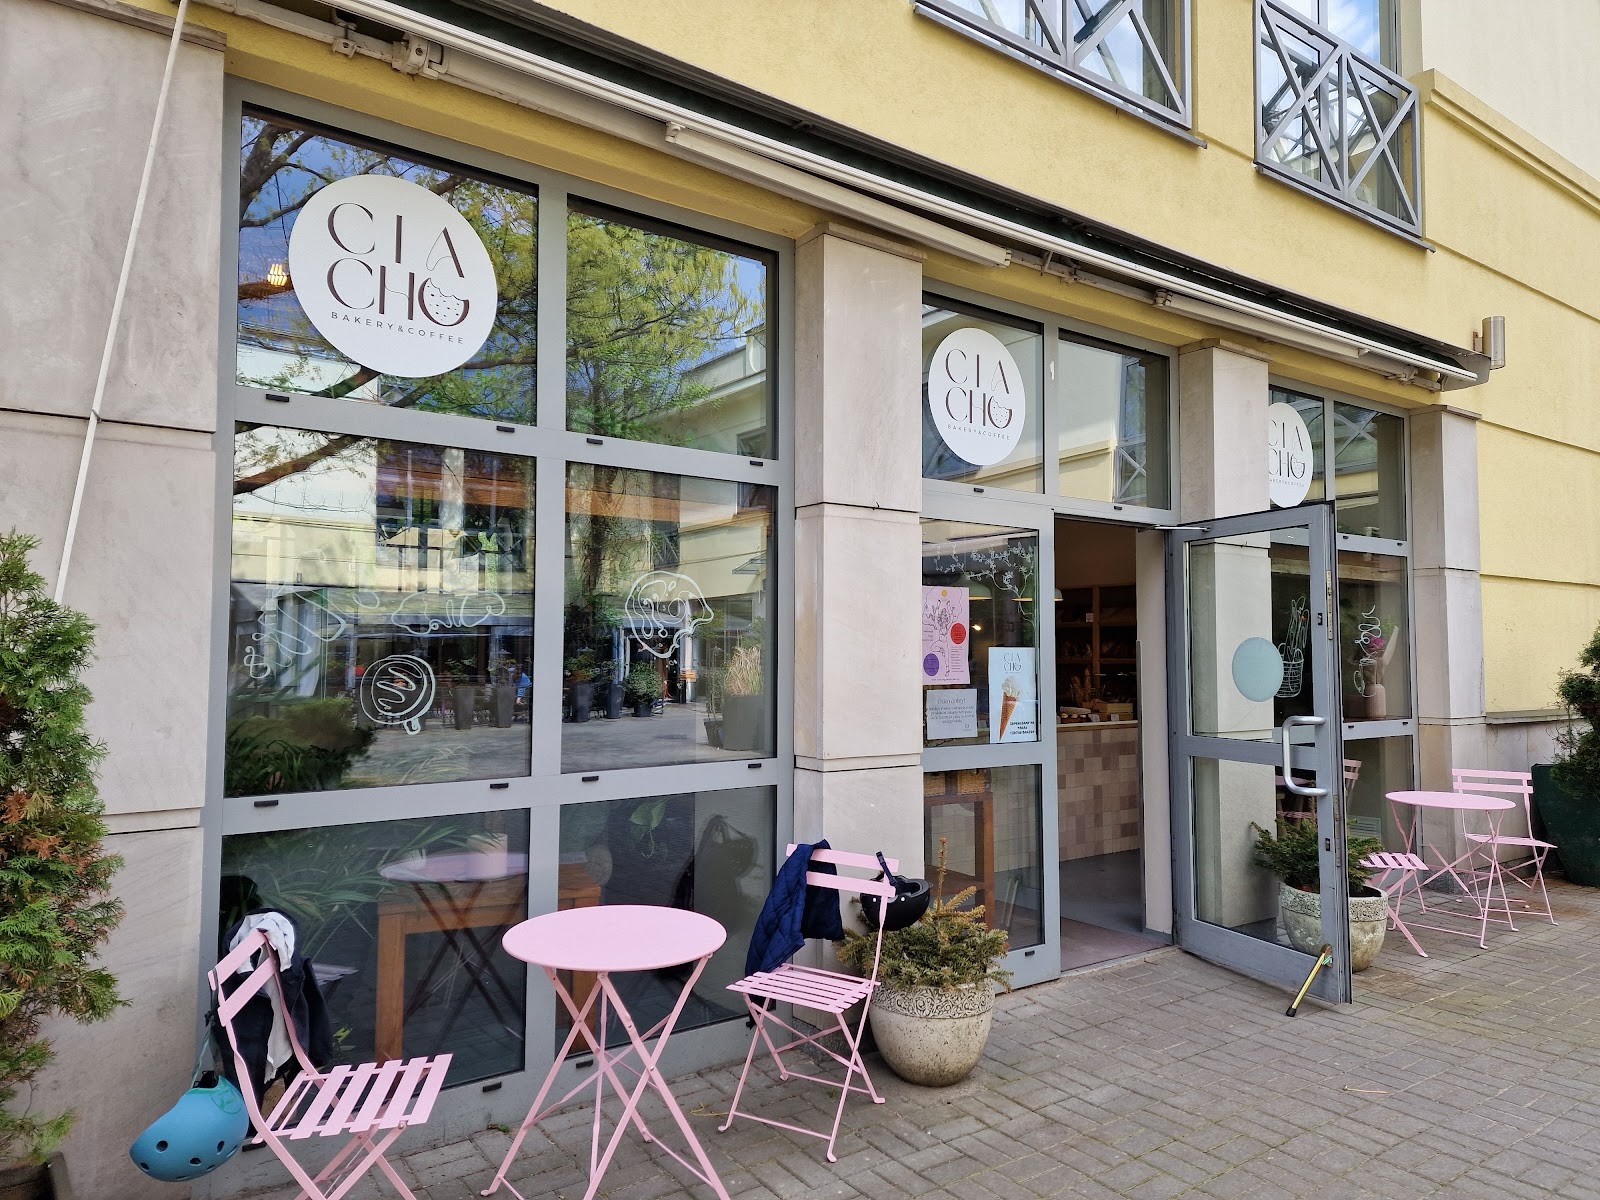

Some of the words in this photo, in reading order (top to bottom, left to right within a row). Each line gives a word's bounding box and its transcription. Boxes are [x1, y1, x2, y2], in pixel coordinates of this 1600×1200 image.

[327, 202, 465, 279] CIA
[326, 257, 470, 327] CHO
[331, 311, 464, 345] BAKERY&COFFEE
[945, 348, 1010, 394] CIA
[945, 386, 1013, 429] CHO
[947, 423, 1010, 440] BAKERY&COFFEE
[1003, 652, 1021, 662] CIA
[1003, 661, 1022, 672] CHO
